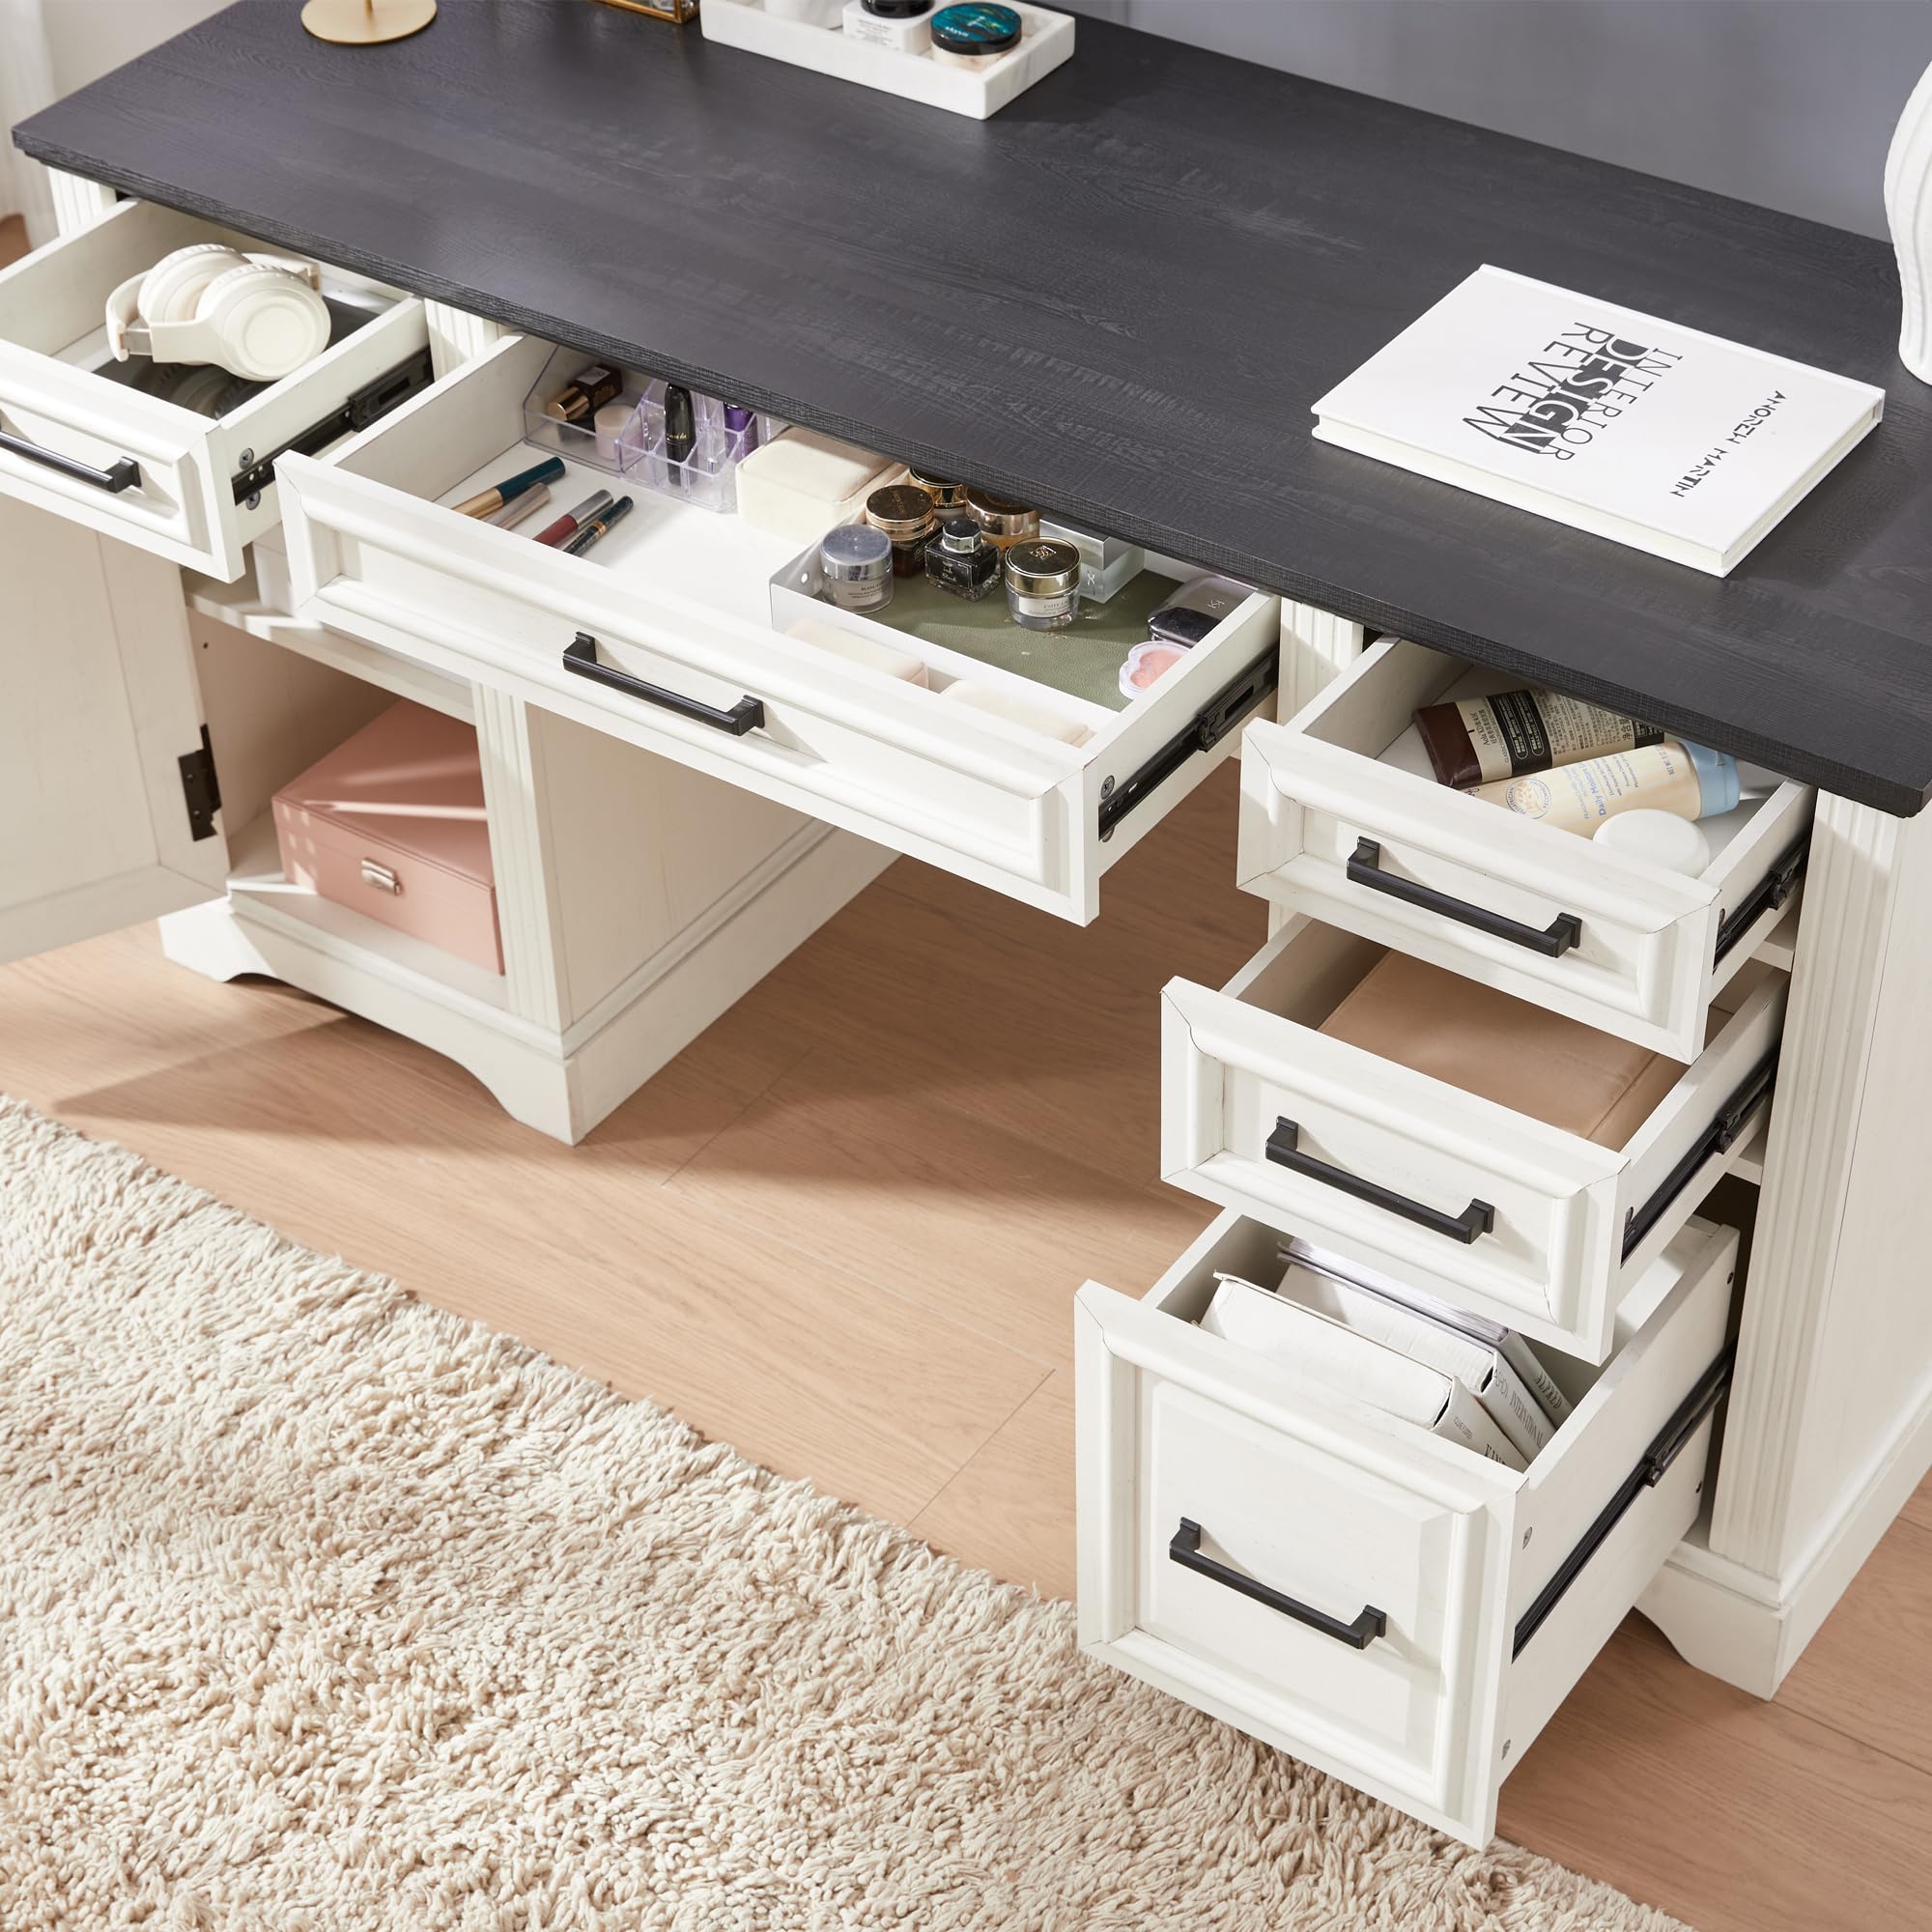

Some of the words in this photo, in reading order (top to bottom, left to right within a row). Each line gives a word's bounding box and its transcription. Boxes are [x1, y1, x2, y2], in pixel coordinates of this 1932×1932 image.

[1462, 322, 1616, 441] REVIEW
[1500, 335, 1652, 454] DESIGN
[1540, 348, 1684, 461] INTERIOR
[1669, 447, 1730, 497] MARTIN
[1595, 795, 1606, 816] Daily
[1534, 1371, 1562, 1408] ALFRED
